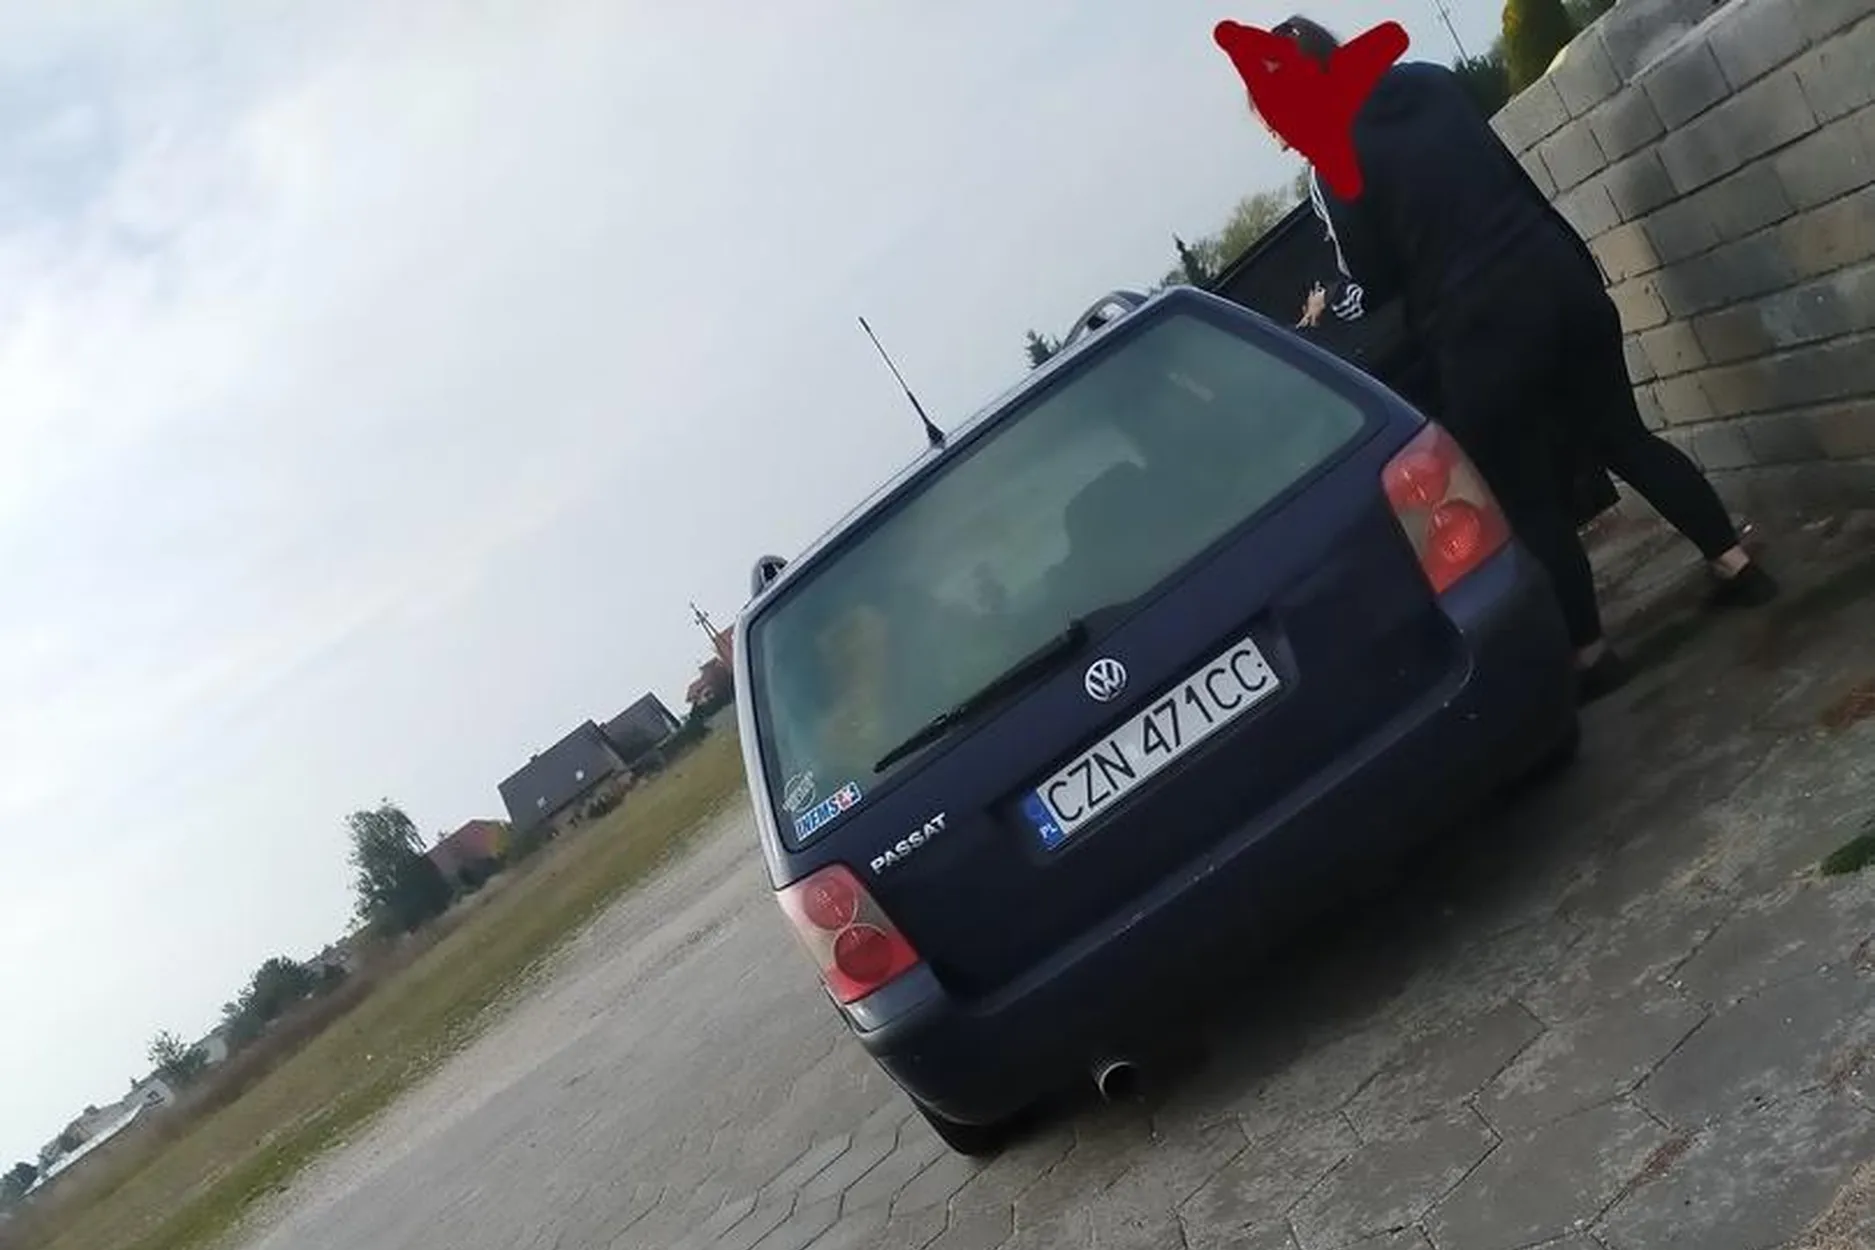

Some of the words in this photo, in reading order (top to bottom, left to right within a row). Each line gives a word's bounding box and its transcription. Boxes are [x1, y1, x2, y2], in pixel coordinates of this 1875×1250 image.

[1047, 740, 1136, 822] CZN
[1142, 649, 1268, 755] 471CC
[870, 812, 947, 875] PASSAT
[1039, 822, 1058, 839] PL
